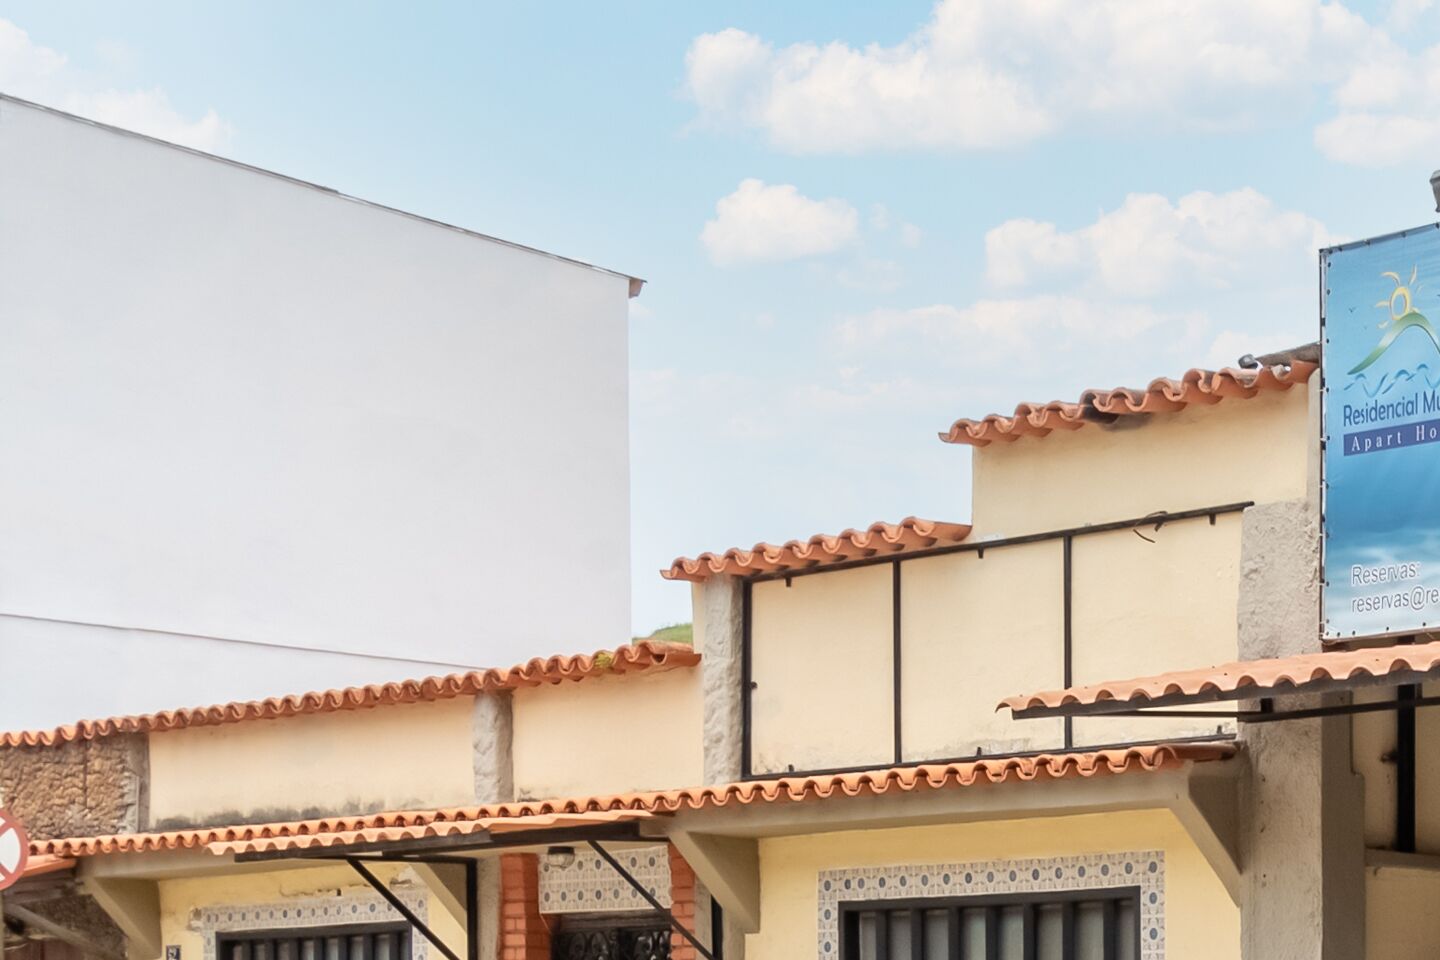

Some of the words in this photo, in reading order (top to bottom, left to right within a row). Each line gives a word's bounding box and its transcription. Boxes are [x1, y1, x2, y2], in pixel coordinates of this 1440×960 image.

[1343, 392, 1419, 427] Residencial
[1351, 431, 1402, 452] Apart
[1351, 561, 1421, 586] Reservas:
